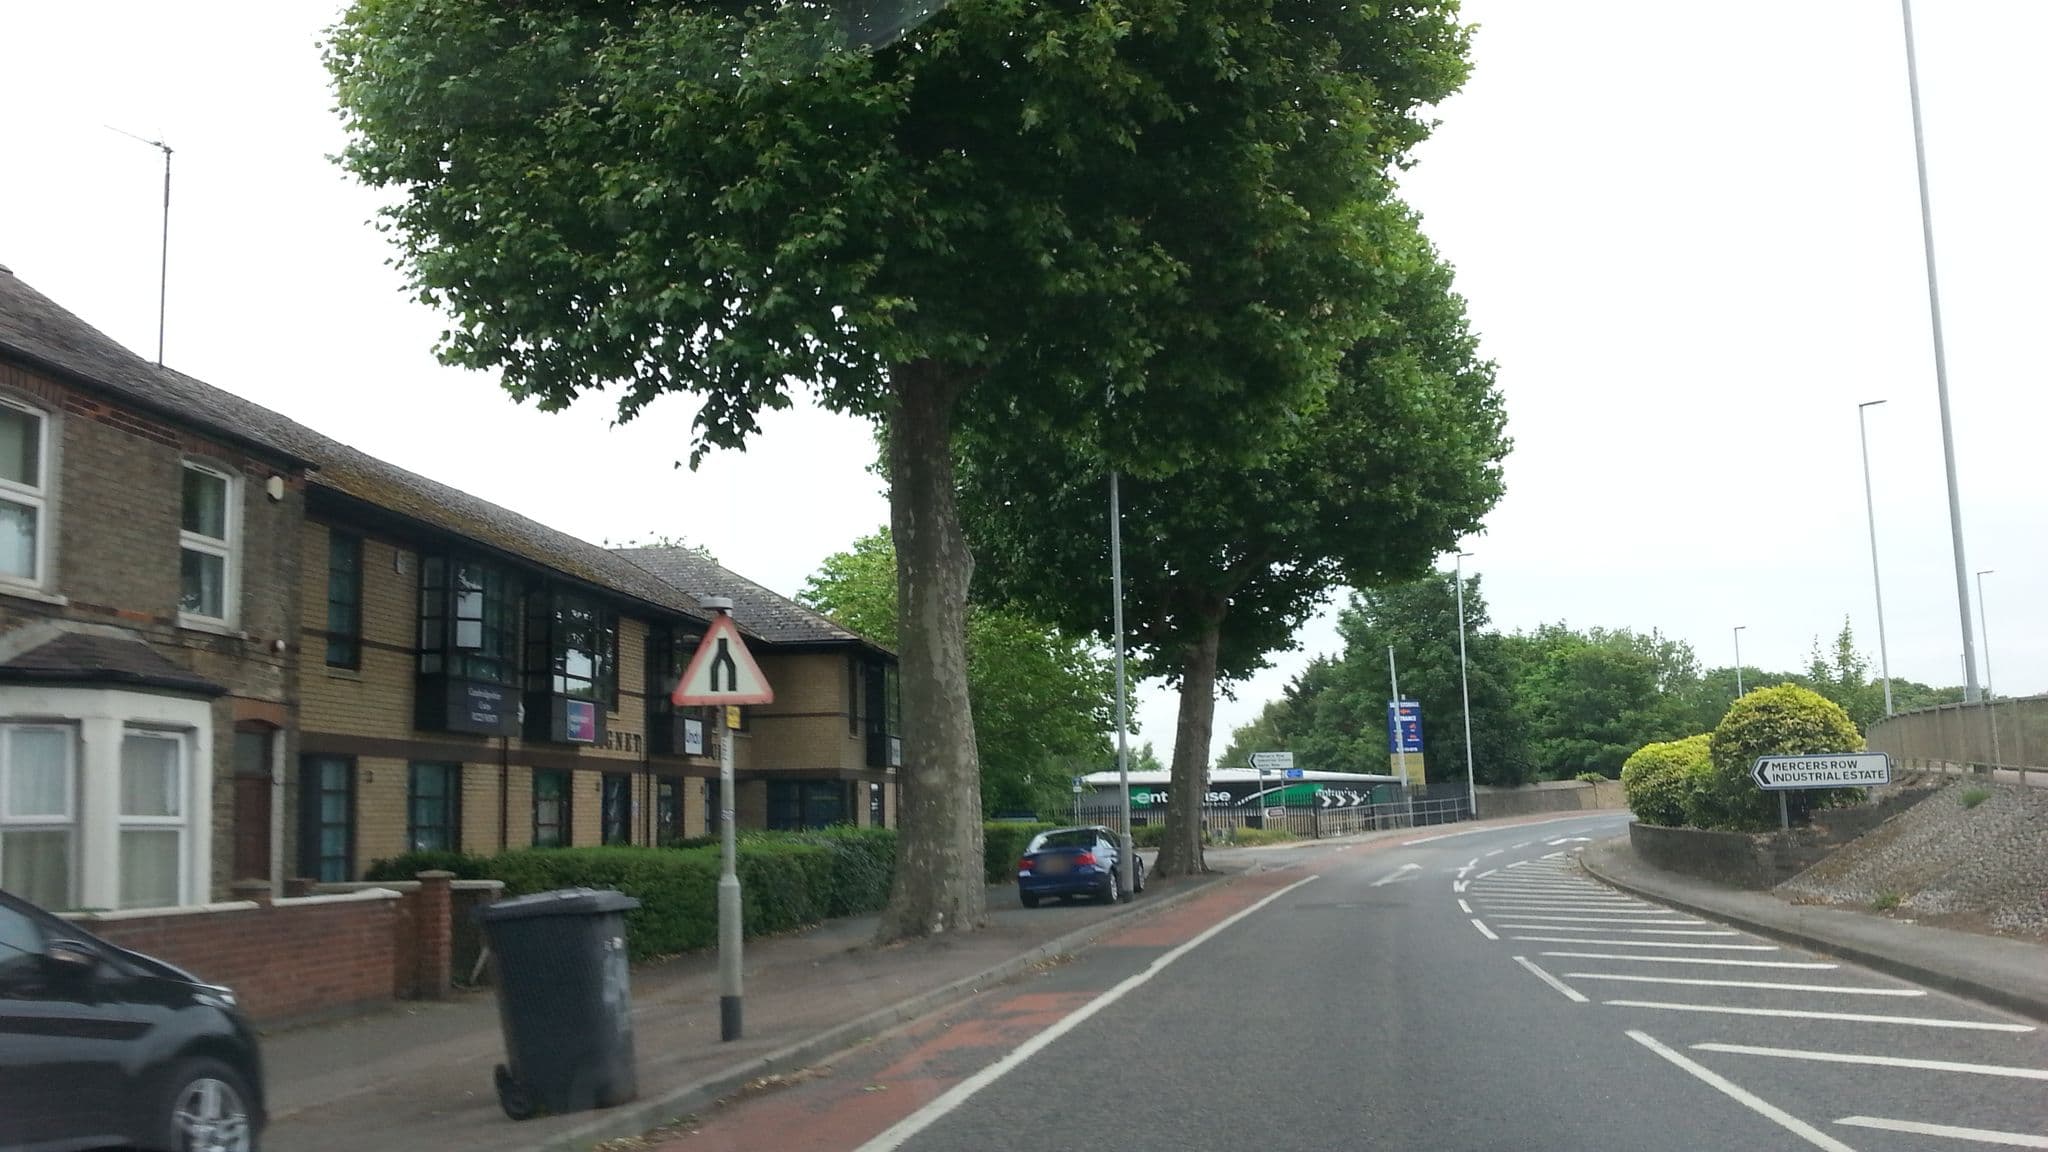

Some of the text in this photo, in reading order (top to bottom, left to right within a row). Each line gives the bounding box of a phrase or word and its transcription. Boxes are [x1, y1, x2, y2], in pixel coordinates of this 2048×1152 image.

[1772, 760, 1858, 771] MERCERS ROW
[1772, 770, 1885, 782] INDUSTRIAL ESTATE
